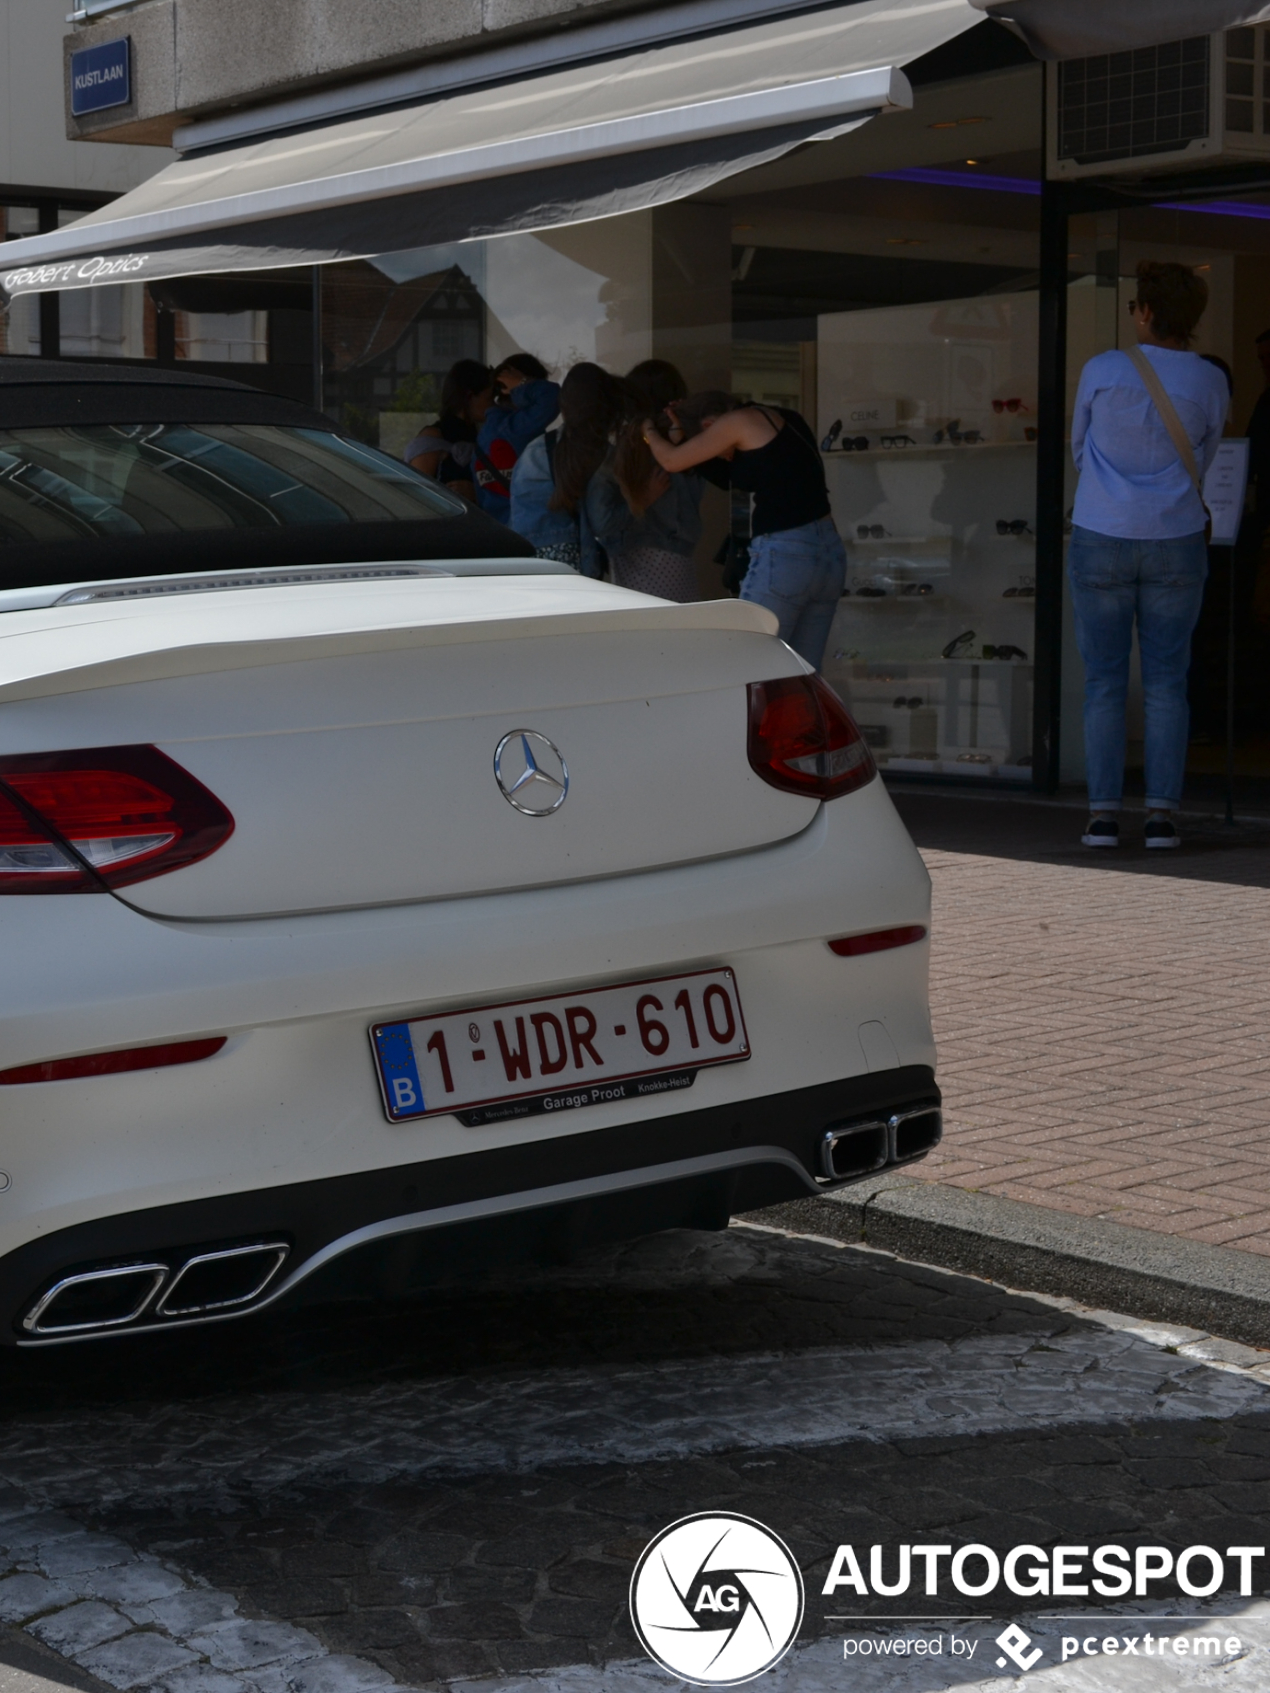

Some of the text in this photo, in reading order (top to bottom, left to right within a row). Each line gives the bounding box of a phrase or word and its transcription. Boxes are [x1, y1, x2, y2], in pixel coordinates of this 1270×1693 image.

[75, 64, 123, 90] KUSTLAAN
[5, 253, 149, 289] Gobert Optics
[850, 409, 879, 421] CELINE
[427, 984, 735, 1093] 1-WDR-610
[543, 1092, 588, 1111] Garage
[591, 1085, 626, 1102] Proot
[638, 1076, 690, 1093] Knokke-Heist
